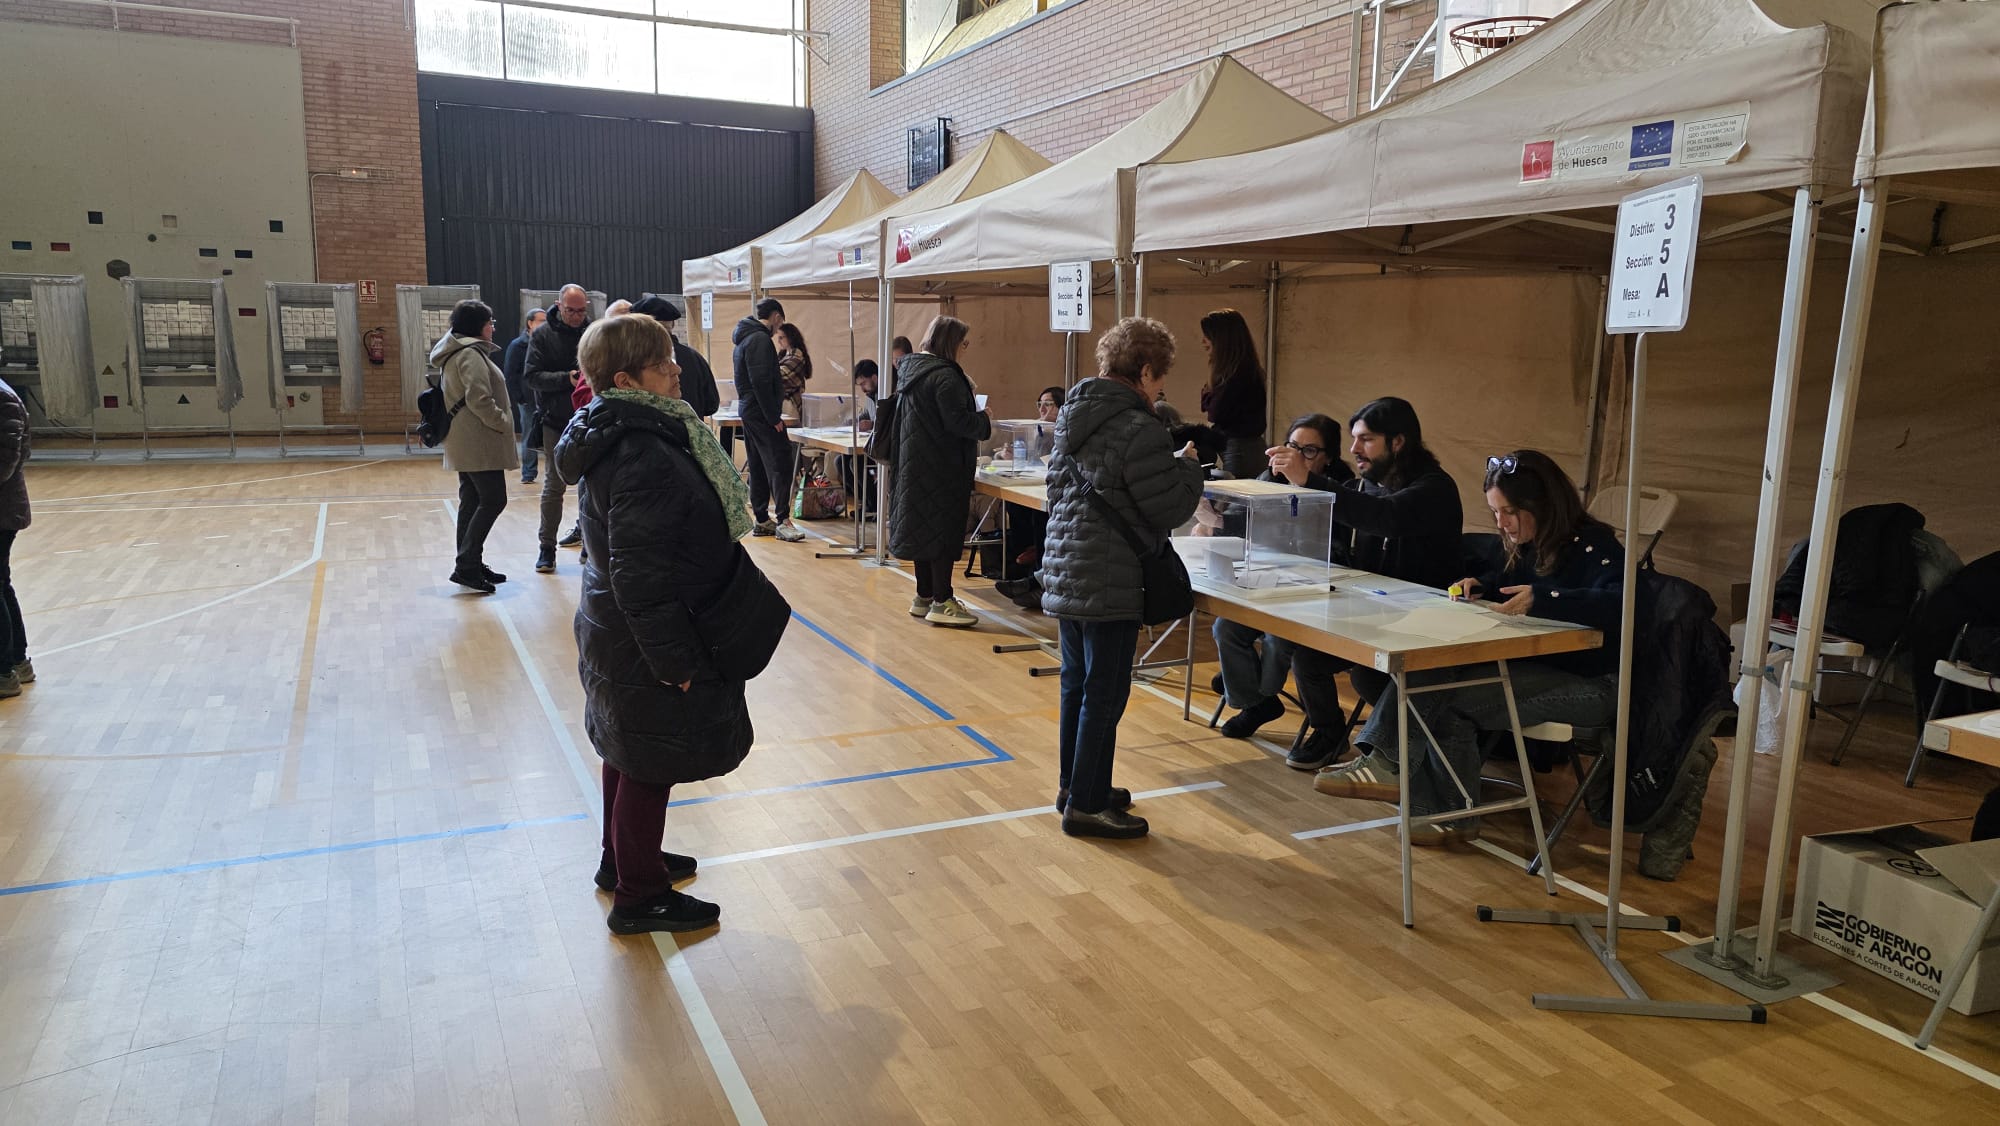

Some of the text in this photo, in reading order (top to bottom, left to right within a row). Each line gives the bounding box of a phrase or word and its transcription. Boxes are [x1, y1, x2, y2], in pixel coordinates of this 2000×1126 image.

[1558, 156, 1608, 170] de Huesca
[1559, 140, 1625, 159] Ayuntamiento
[1629, 203, 1676, 238] Distrito: 3
[1659, 238, 1672, 265] 5
[1076, 268, 1082, 283] 3
[1622, 272, 1669, 301] Mesa: A
[1076, 285, 1083, 300] 4
[1077, 303, 1083, 316] B
[1845, 914, 1932, 962] GOBIERNO
[1813, 931, 1856, 957] ELECCIONES
[1856, 952, 1863, 961] A
[1863, 955, 1892, 974] CORTES
[1893, 969, 1905, 980] DE
[1843, 927, 1943, 984] DE ARAGON
